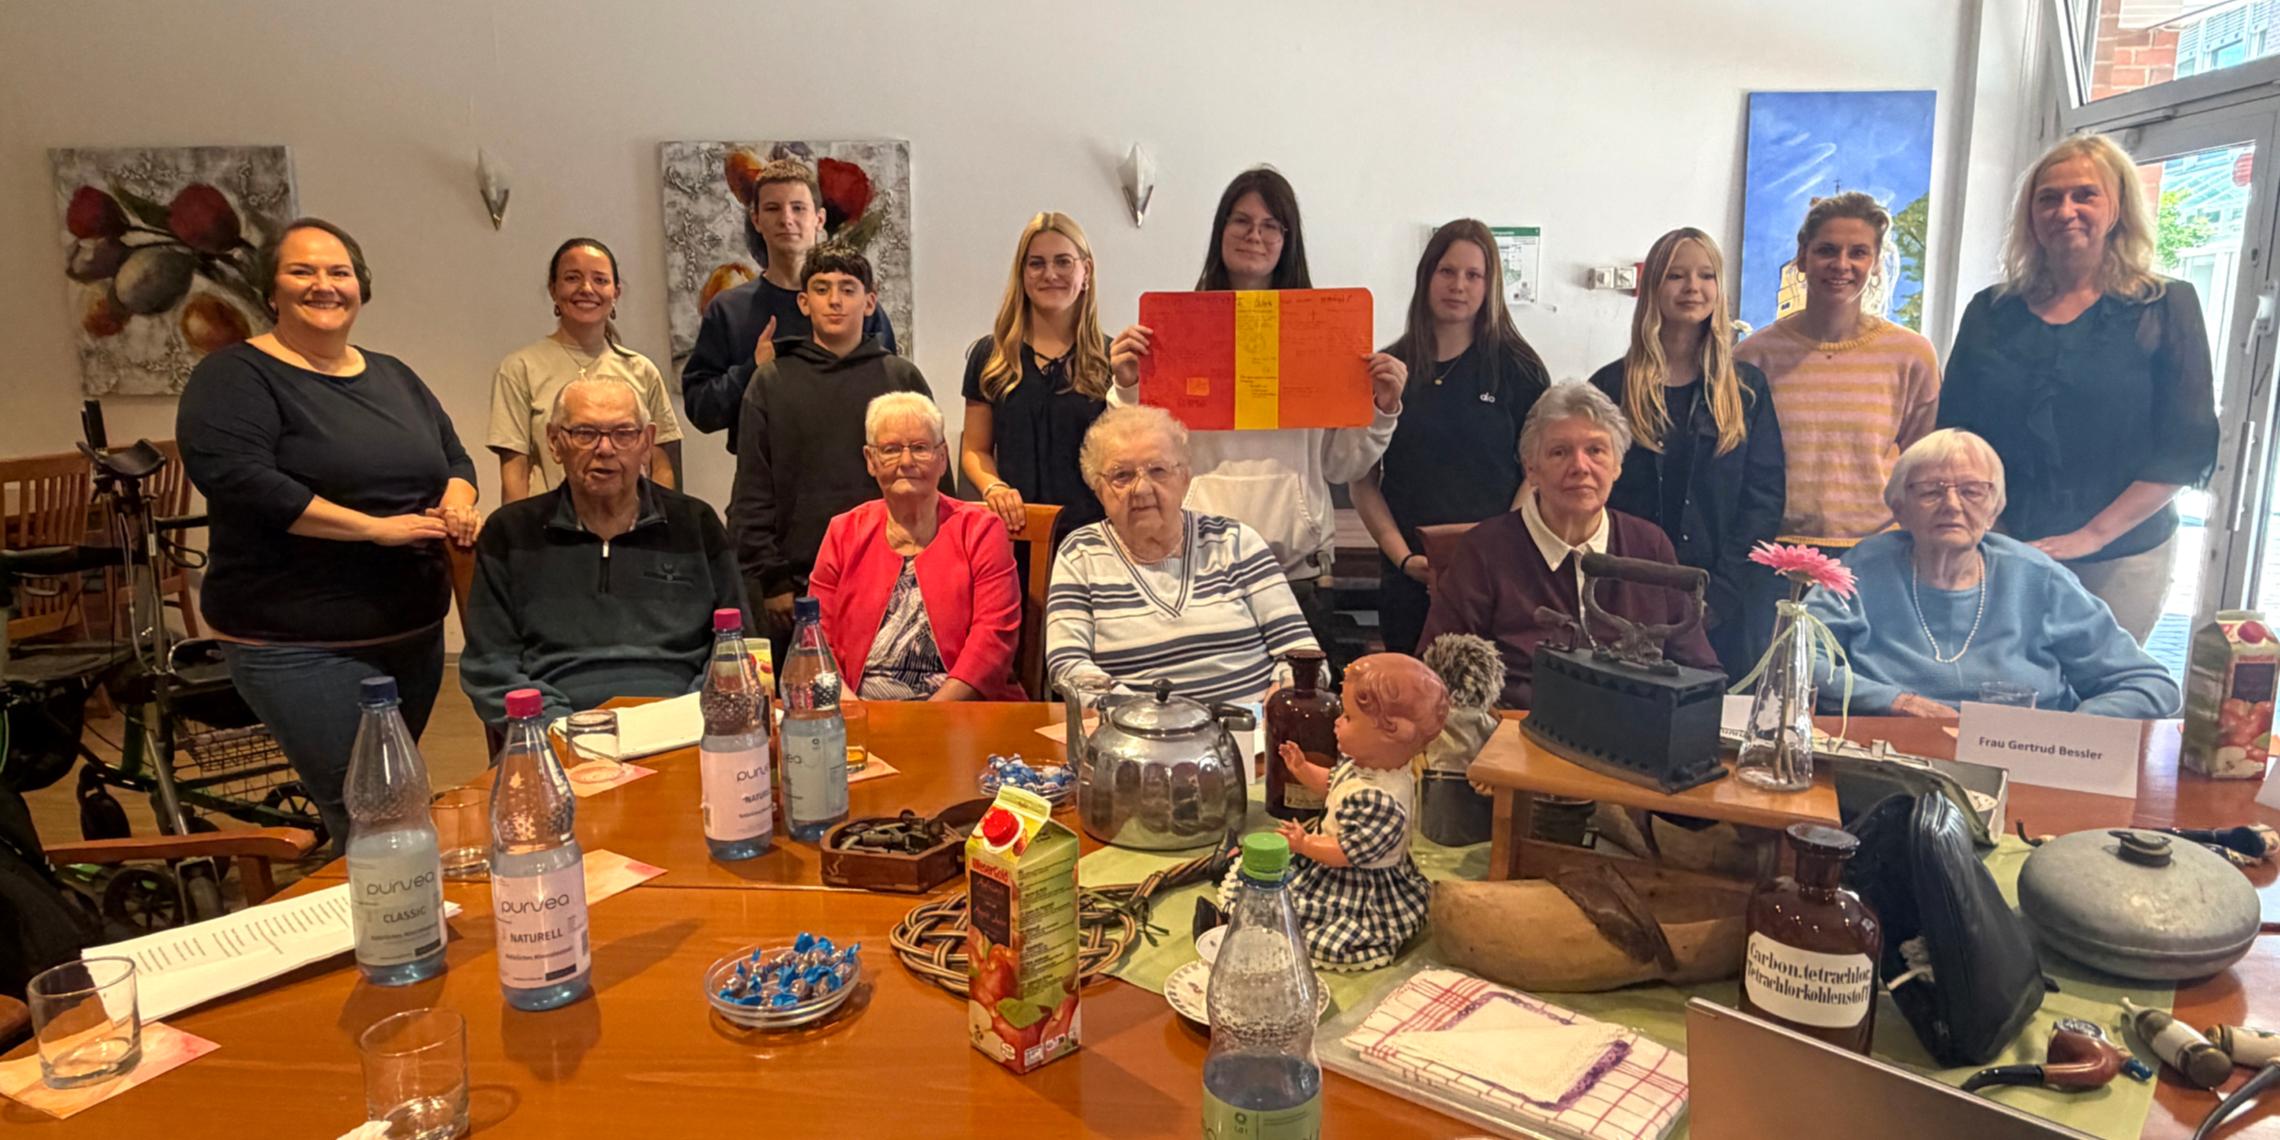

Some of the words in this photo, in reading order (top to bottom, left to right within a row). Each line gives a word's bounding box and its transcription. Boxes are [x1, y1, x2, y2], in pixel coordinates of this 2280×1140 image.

[1979, 736, 2005, 748] Frau
[2008, 740, 2056, 755] Gertrud
[2059, 745, 2103, 760] Bessler
[366, 871, 435, 895] purvea
[501, 894, 570, 914] purvea
[383, 905, 426, 924] CLASSIC
[510, 928, 563, 943] NATURELL
